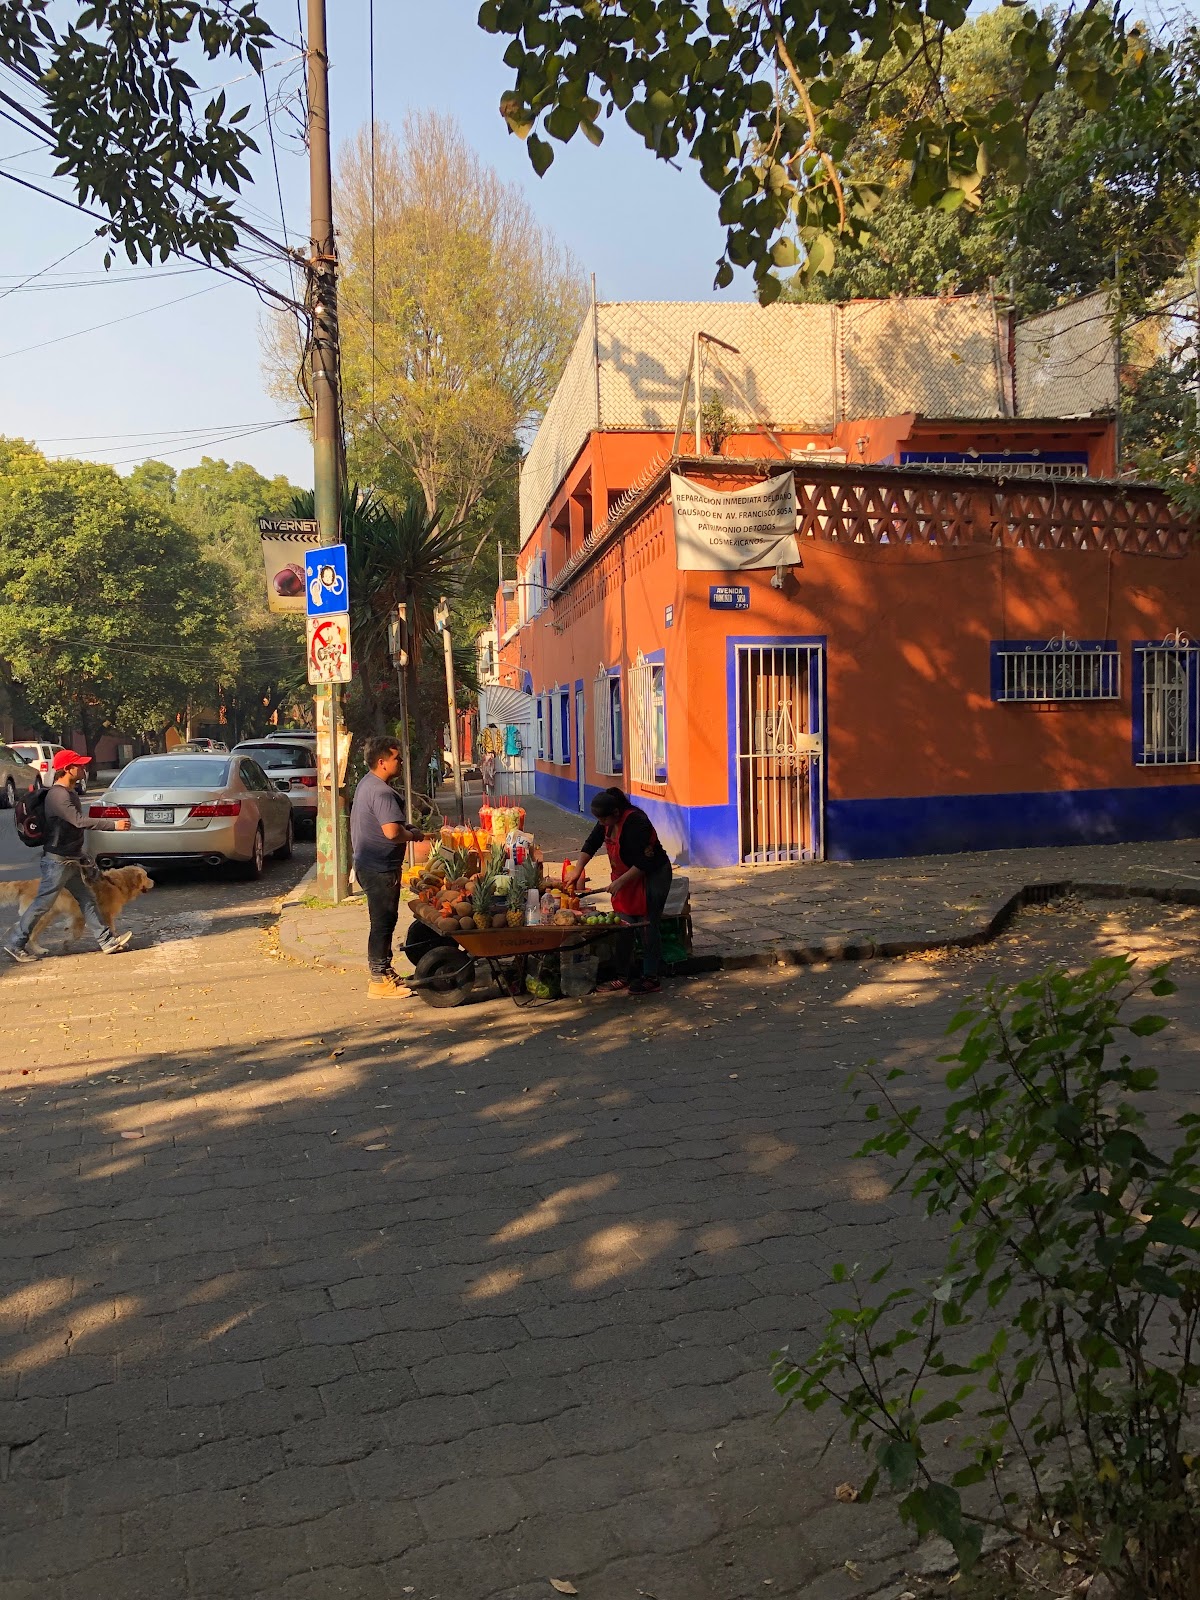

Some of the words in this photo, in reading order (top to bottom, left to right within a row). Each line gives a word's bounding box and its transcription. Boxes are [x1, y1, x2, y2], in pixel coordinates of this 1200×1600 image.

[676, 494, 721, 506] REPARACIÓN
[722, 496, 762, 505] INMEDIATA
[763, 495, 775, 503] DEL
[775, 492, 792, 501] DAÑO
[677, 508, 711, 518] CAUSADO
[712, 511, 723, 519] EN
[738, 509, 776, 519] FRANCISCO
[776, 507, 793, 516] SOSA
[259, 519, 317, 532] INTERNET
[698, 523, 742, 533] PATRIMONIO
[743, 524, 753, 533] DE
[753, 523, 776, 532] TODOS
[709, 537, 723, 545] LOS
